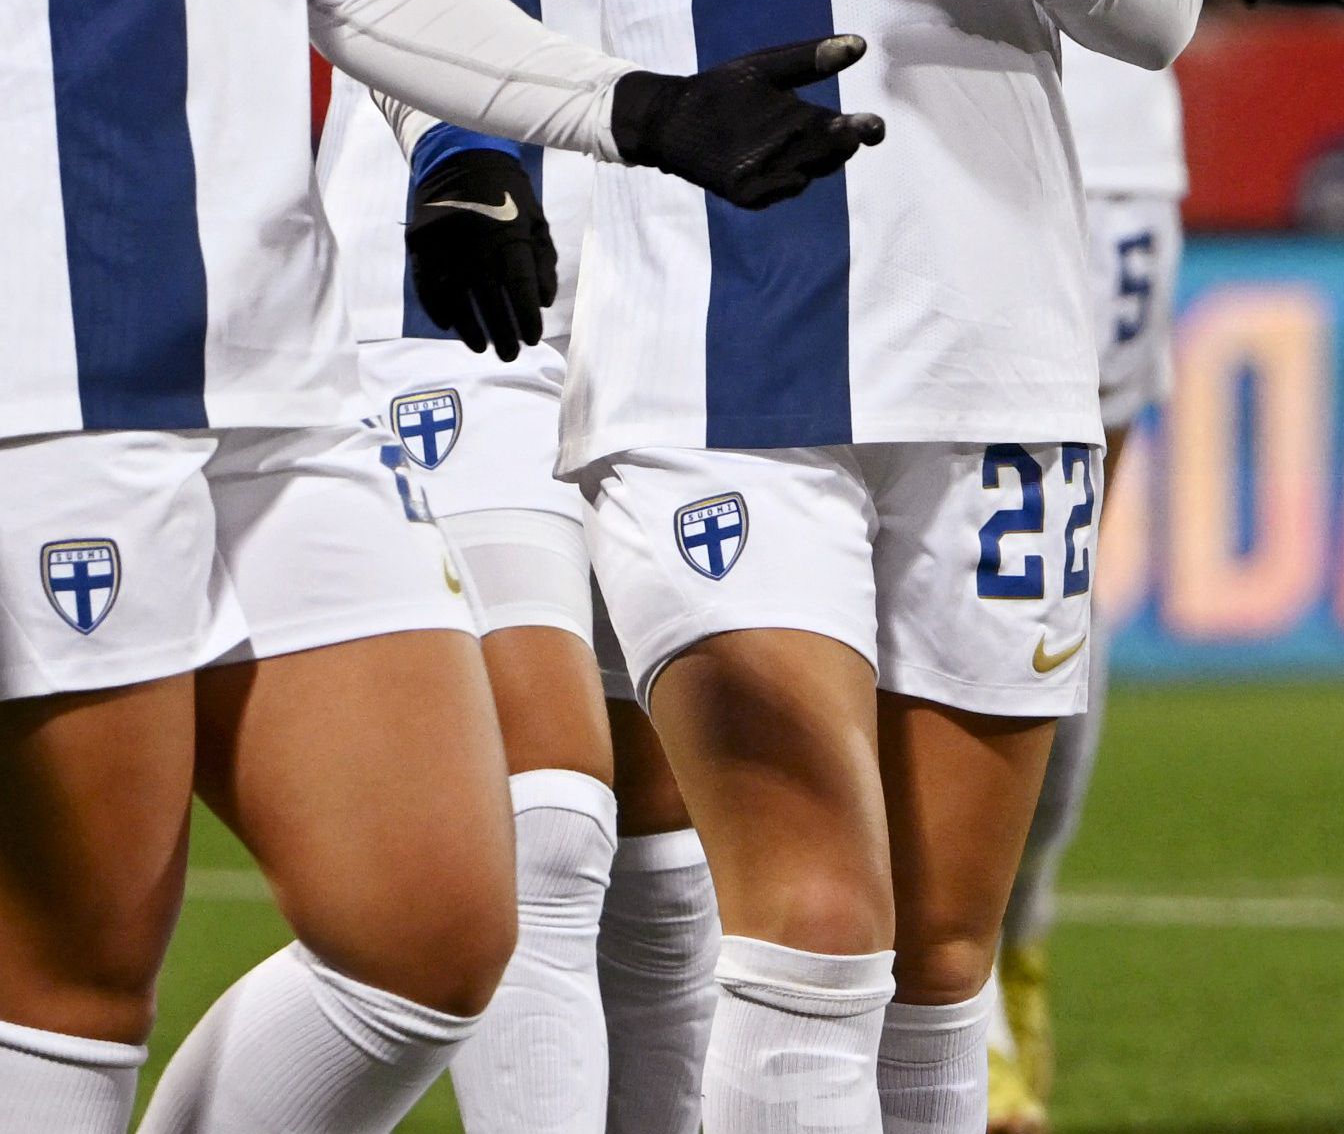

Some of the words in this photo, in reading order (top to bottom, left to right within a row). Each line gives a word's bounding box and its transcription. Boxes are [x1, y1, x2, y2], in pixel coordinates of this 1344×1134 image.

[1117, 231, 1154, 343] 5
[404, 398, 448, 412] SUOMI
[688, 504, 732, 522] SUOMI
[976, 443, 1094, 600] 22
[56, 550, 103, 562] SUOMI
